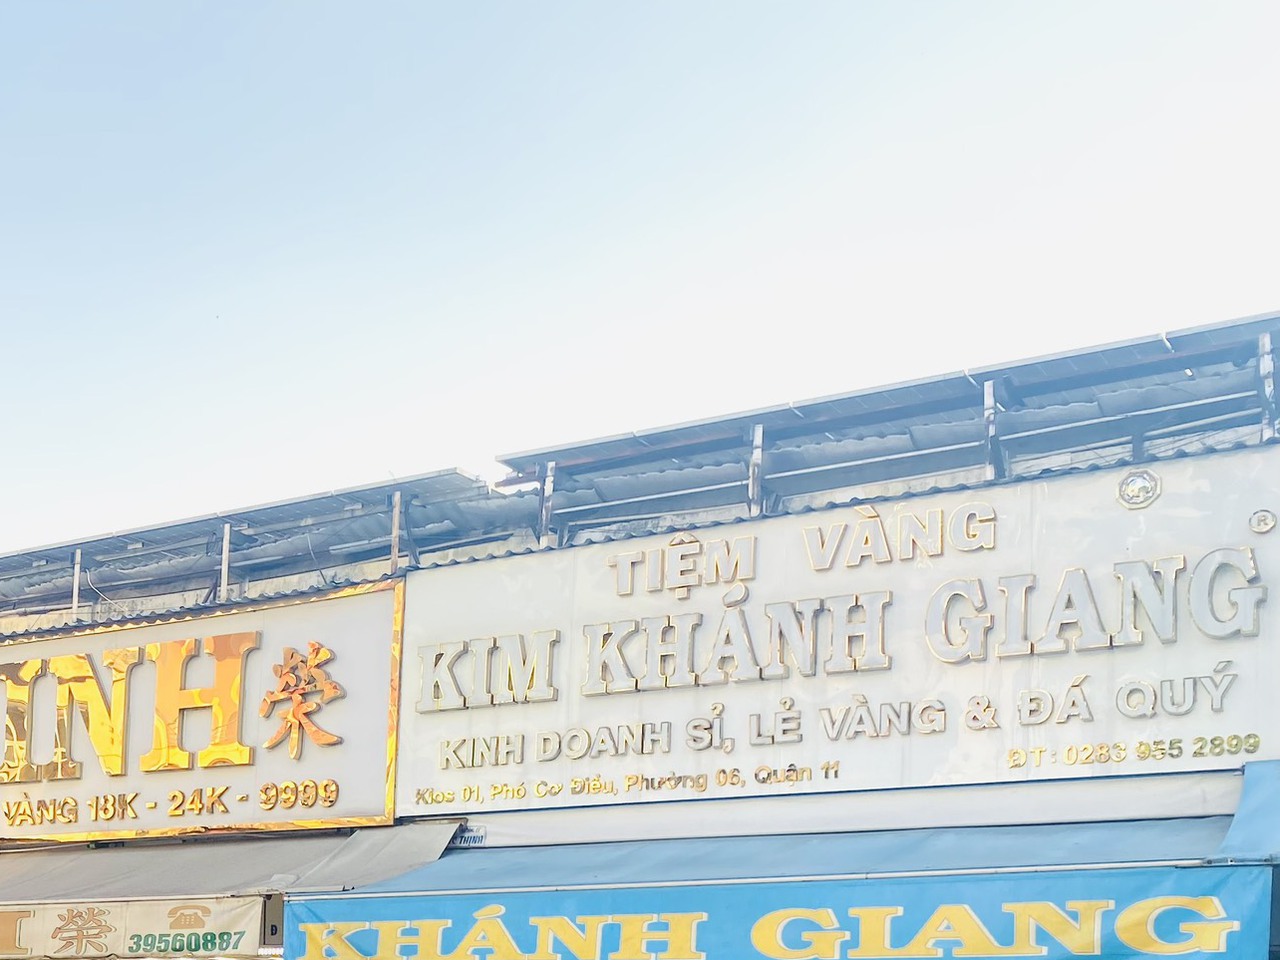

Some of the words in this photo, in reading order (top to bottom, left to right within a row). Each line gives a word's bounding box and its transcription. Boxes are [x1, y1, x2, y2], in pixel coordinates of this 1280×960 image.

[607, 533, 758, 600] TIỆM
[802, 502, 998, 570] VÀNG
[415, 629, 561, 714] KIM
[580, 581, 894, 697] KHÁNH
[924, 546, 1268, 664] GIANG
[258, 640, 346, 760] 榮
[438, 733, 525, 770] KINH
[536, 721, 672, 763] DOANH
[685, 702, 735, 756] SỈ,
[749, 697, 803, 746] LẺ
[819, 693, 947, 741] VÀNG
[965, 693, 999, 731] &
[1017, 674, 1095, 726] ĐÁ
[1115, 659, 1239, 720] QUÝ
[415, 787, 455, 804] Kios
[754, 763, 812, 786] Quận
[821, 760, 840, 779] 11
[1007, 745, 1057, 768] ĐT:
[1062, 742, 1126, 766] 0283
[1135, 738, 1184, 761] 955
[1192, 732, 1261, 758] 2899
[2, 791, 79, 827] VÀNG
[87, 791, 143, 821] 18K
[167, 785, 230, 817] 24K
[258, 778, 340, 812] 9999
[128, 930, 246, 954] 39560887
[750, 895, 1241, 960] GIANG
